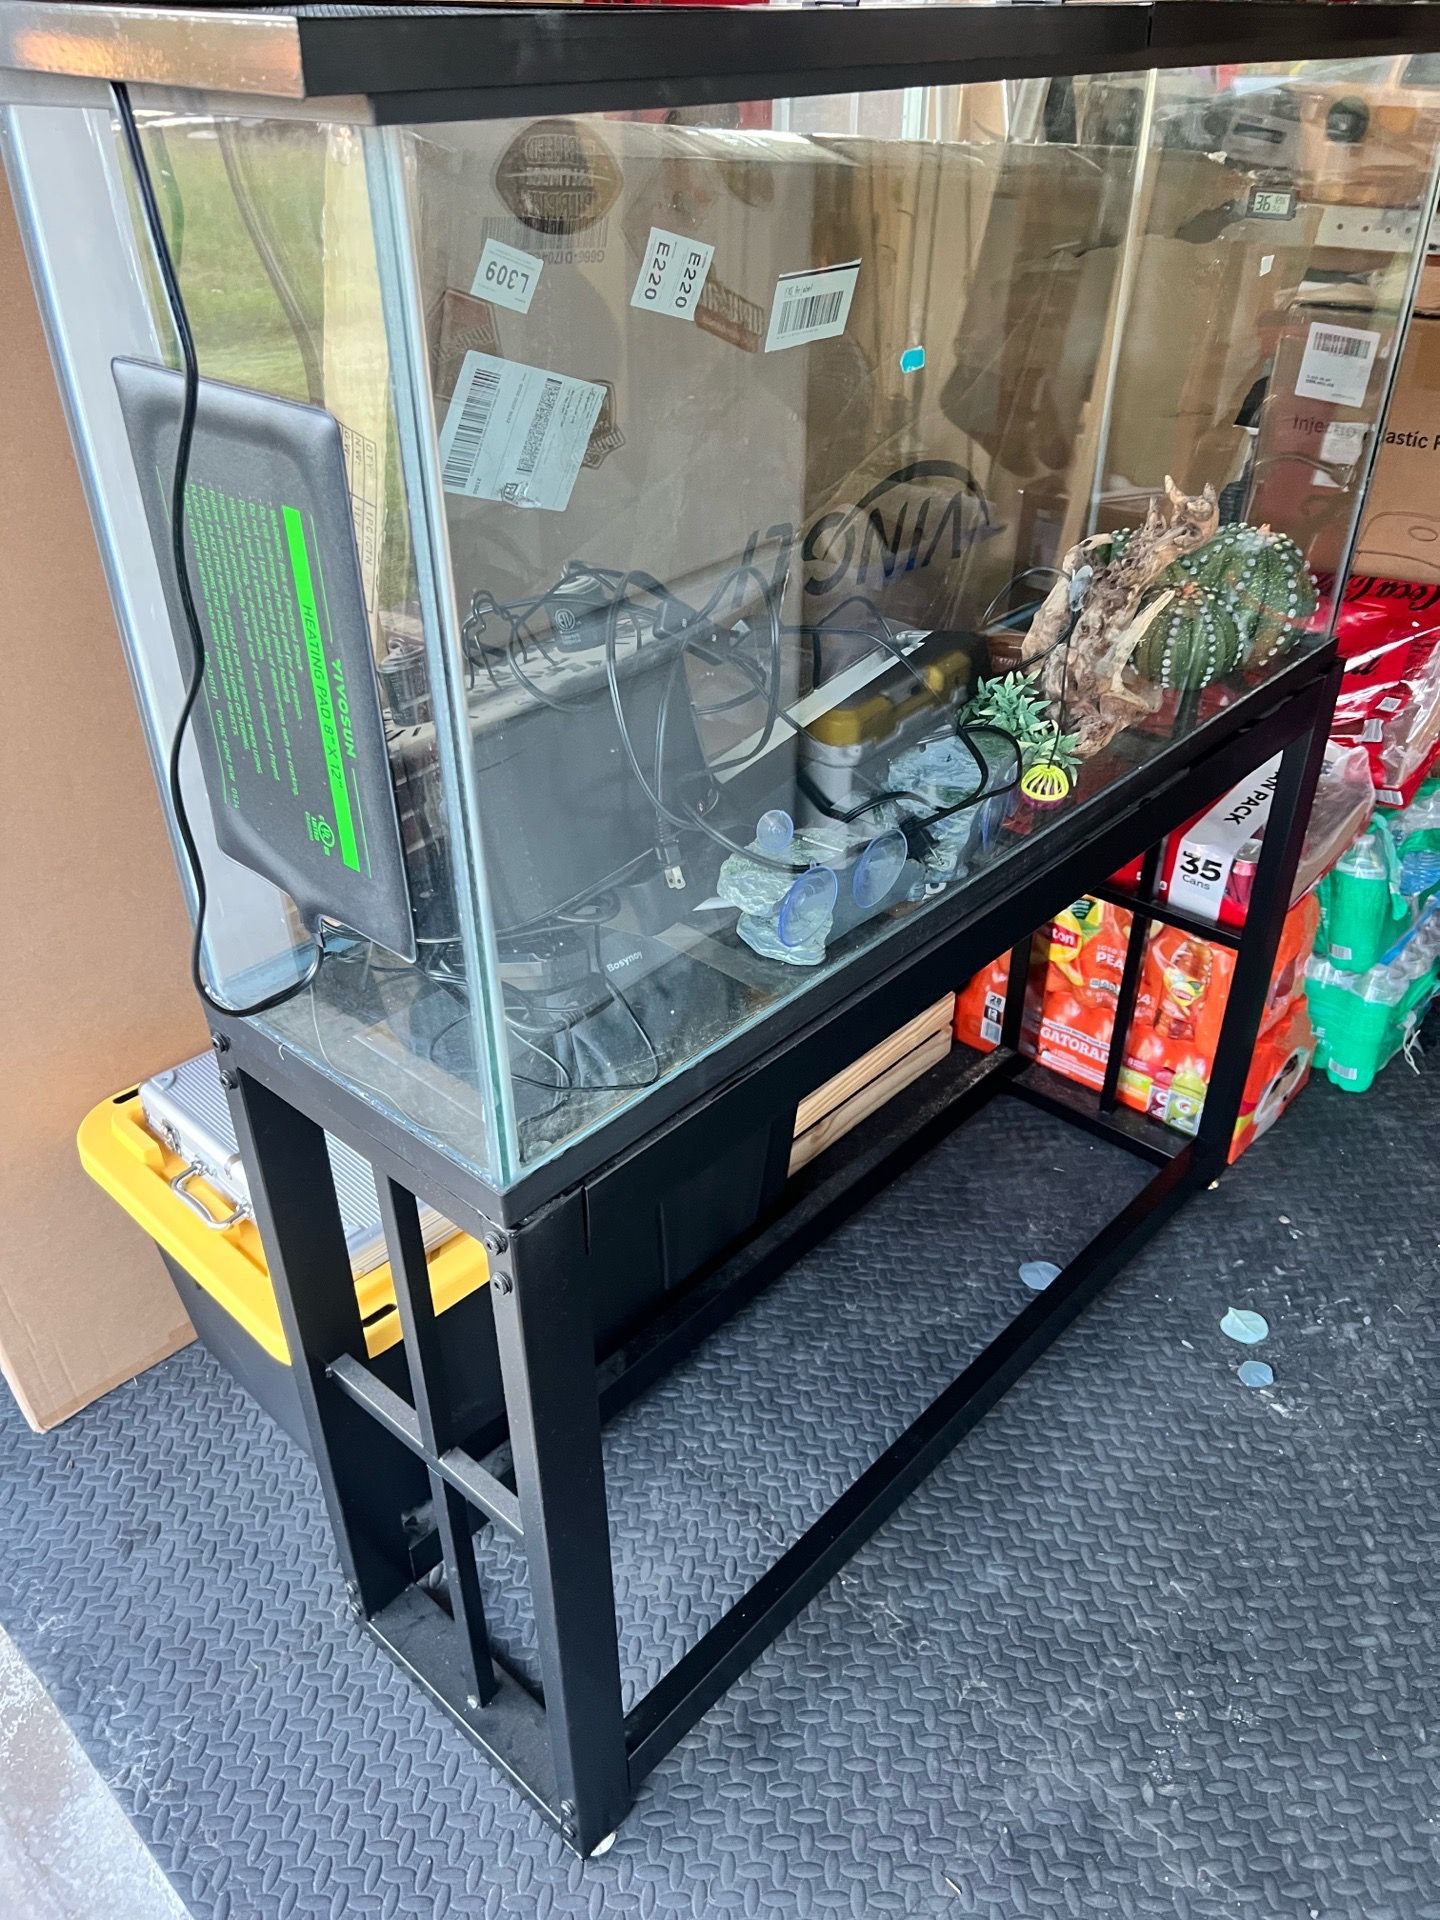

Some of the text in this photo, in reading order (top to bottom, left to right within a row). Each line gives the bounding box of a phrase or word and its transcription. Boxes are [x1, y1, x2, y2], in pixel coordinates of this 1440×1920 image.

[486, 261, 529, 293] L309
[644, 242, 670, 300] E220
[675, 252, 701, 308] E220
[1381, 427, 1428, 448] lastic
[303, 605, 323, 680] HEATING
[317, 685, 330, 719] PAD
[328, 746, 336, 757] X
[332, 657, 355, 758] VIVOSUN
[1223, 790, 1269, 825] PACK
[1180, 851, 1222, 882] 35
[1182, 874, 1210, 891] Cans
[1052, 927, 1076, 946] ton
[1040, 1026, 1110, 1064] GATORAD
